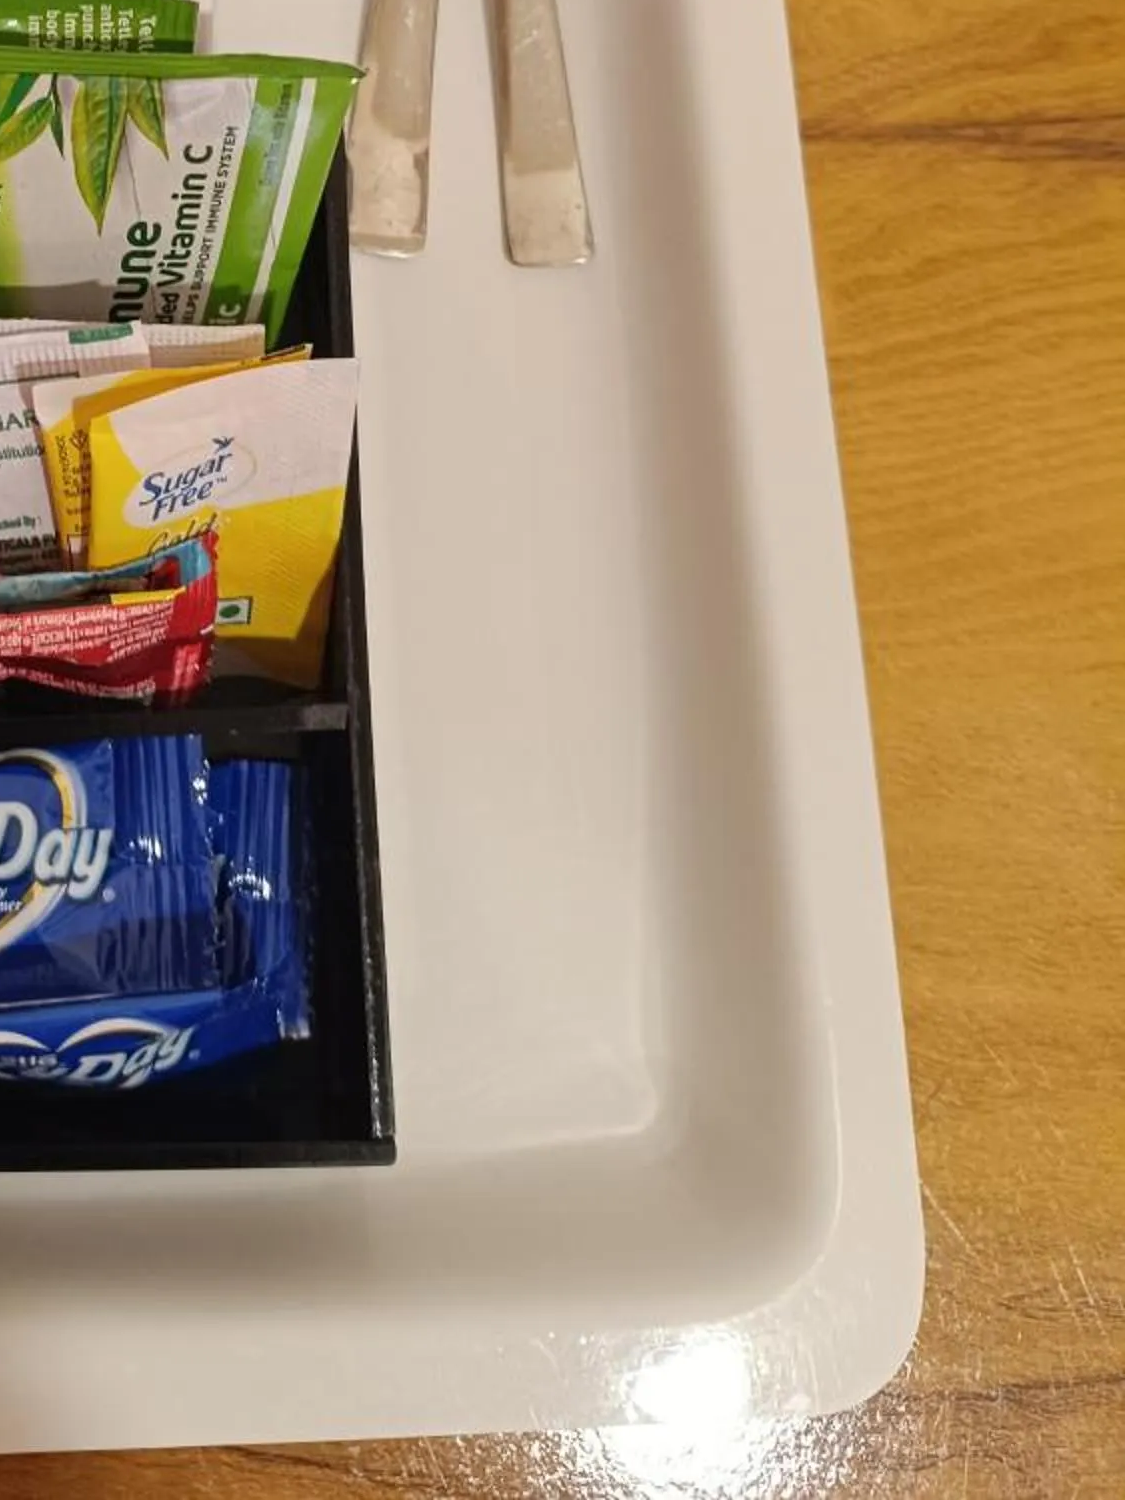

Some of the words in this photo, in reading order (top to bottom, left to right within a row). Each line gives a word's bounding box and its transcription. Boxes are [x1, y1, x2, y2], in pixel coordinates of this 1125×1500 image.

[139, 14, 157, 51] Tetl
[183, 143, 213, 164] C
[156, 173, 207, 287] Vitamin
[189, 238, 214, 291] SUPPORT
[204, 182, 227, 234] IMMUNE
[217, 125, 239, 178] SYSTEM
[109, 221, 162, 323] mune
[155, 293, 179, 323] ded
[139, 453, 233, 506] Sugar
[152, 482, 213, 521] Free
